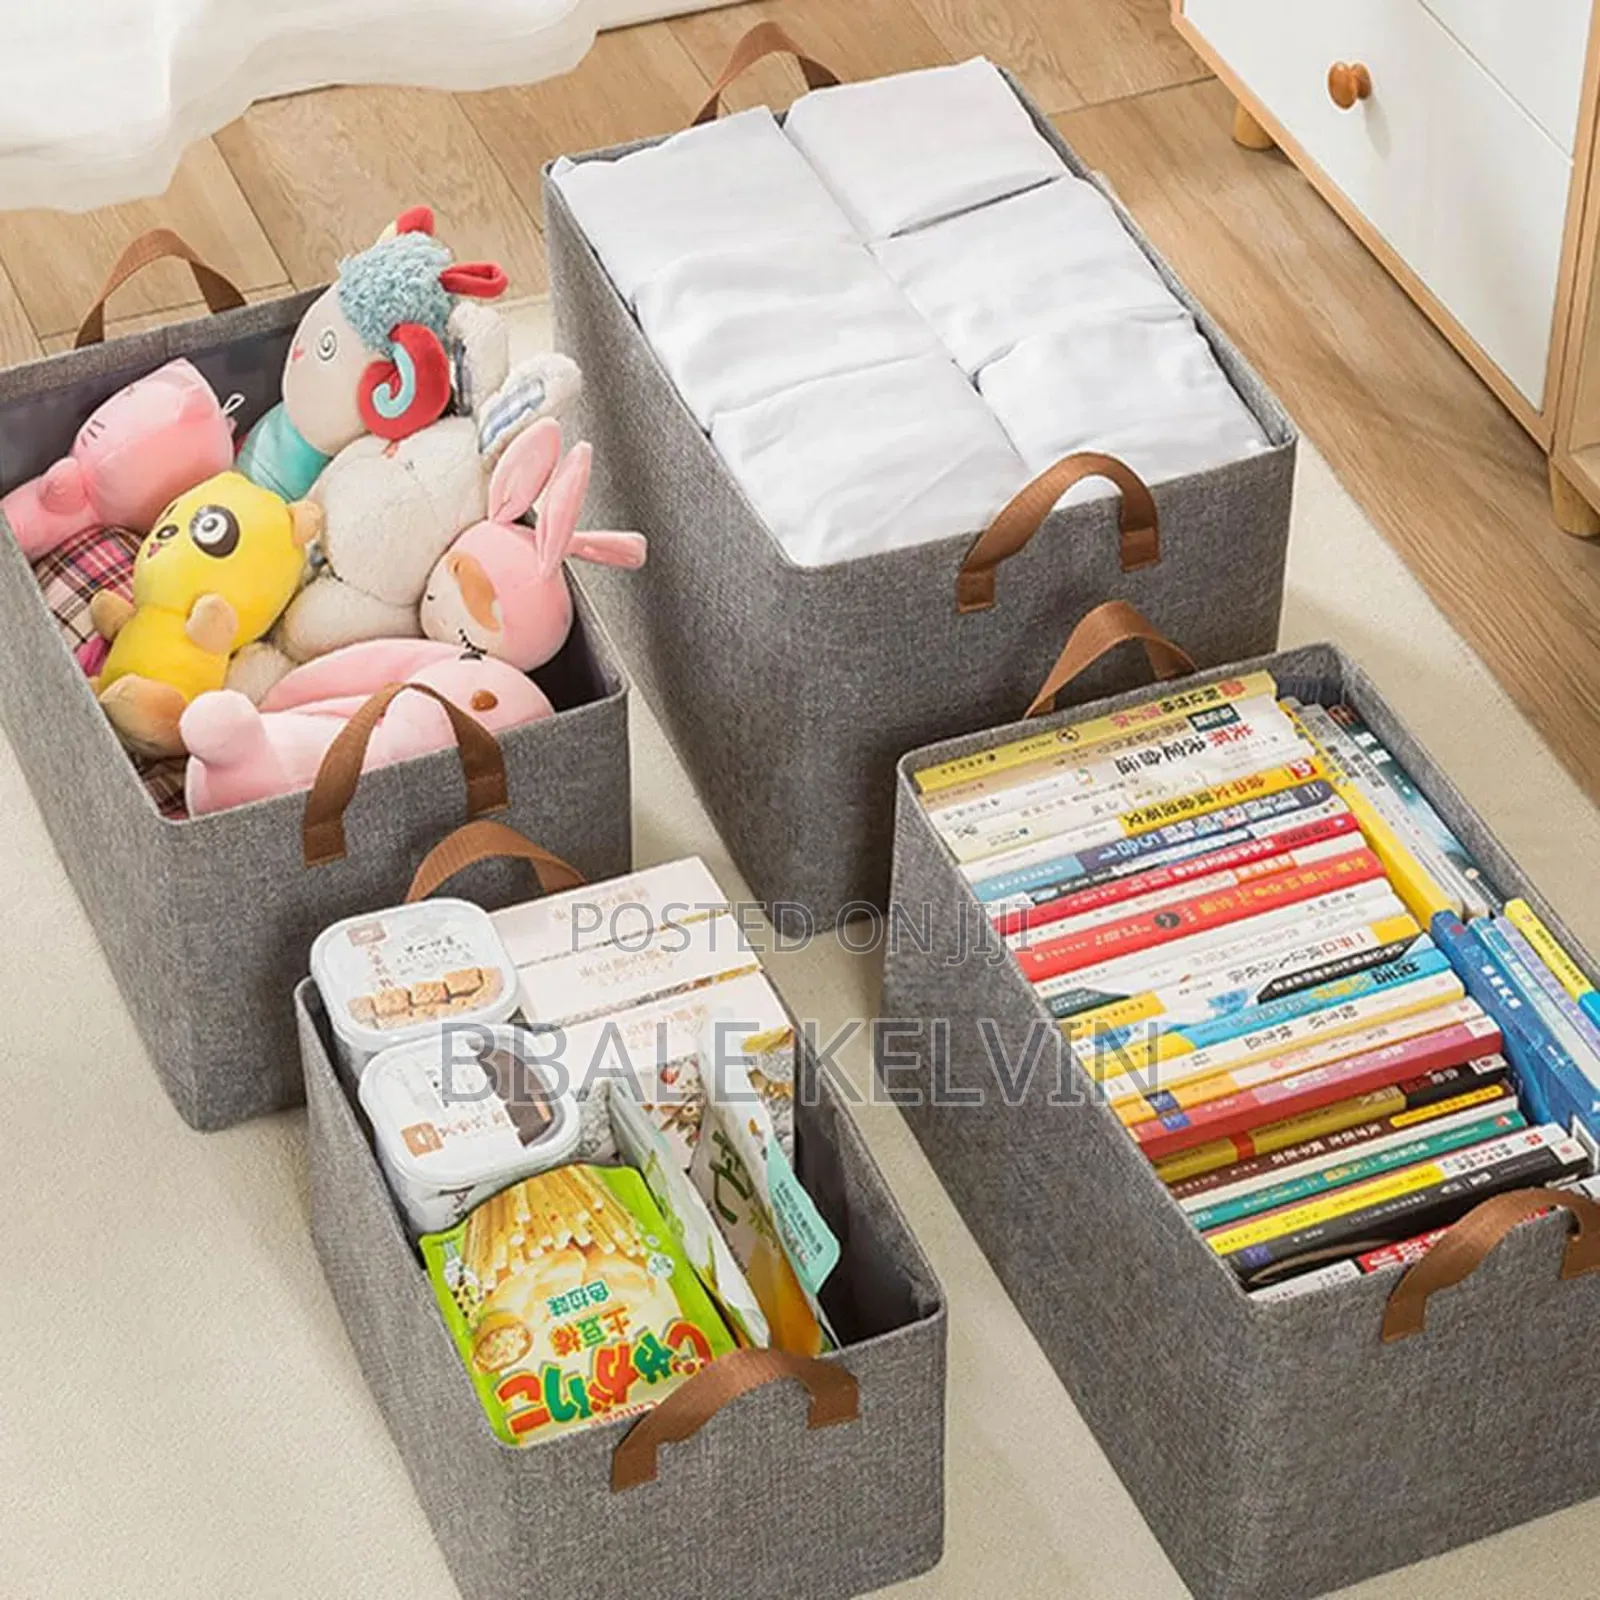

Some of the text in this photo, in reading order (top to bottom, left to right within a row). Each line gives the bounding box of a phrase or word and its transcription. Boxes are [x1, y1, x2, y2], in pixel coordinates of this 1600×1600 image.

[546, 1279, 610, 1318] 色拉味
[496, 1320, 716, 1436] じゃがりこ
